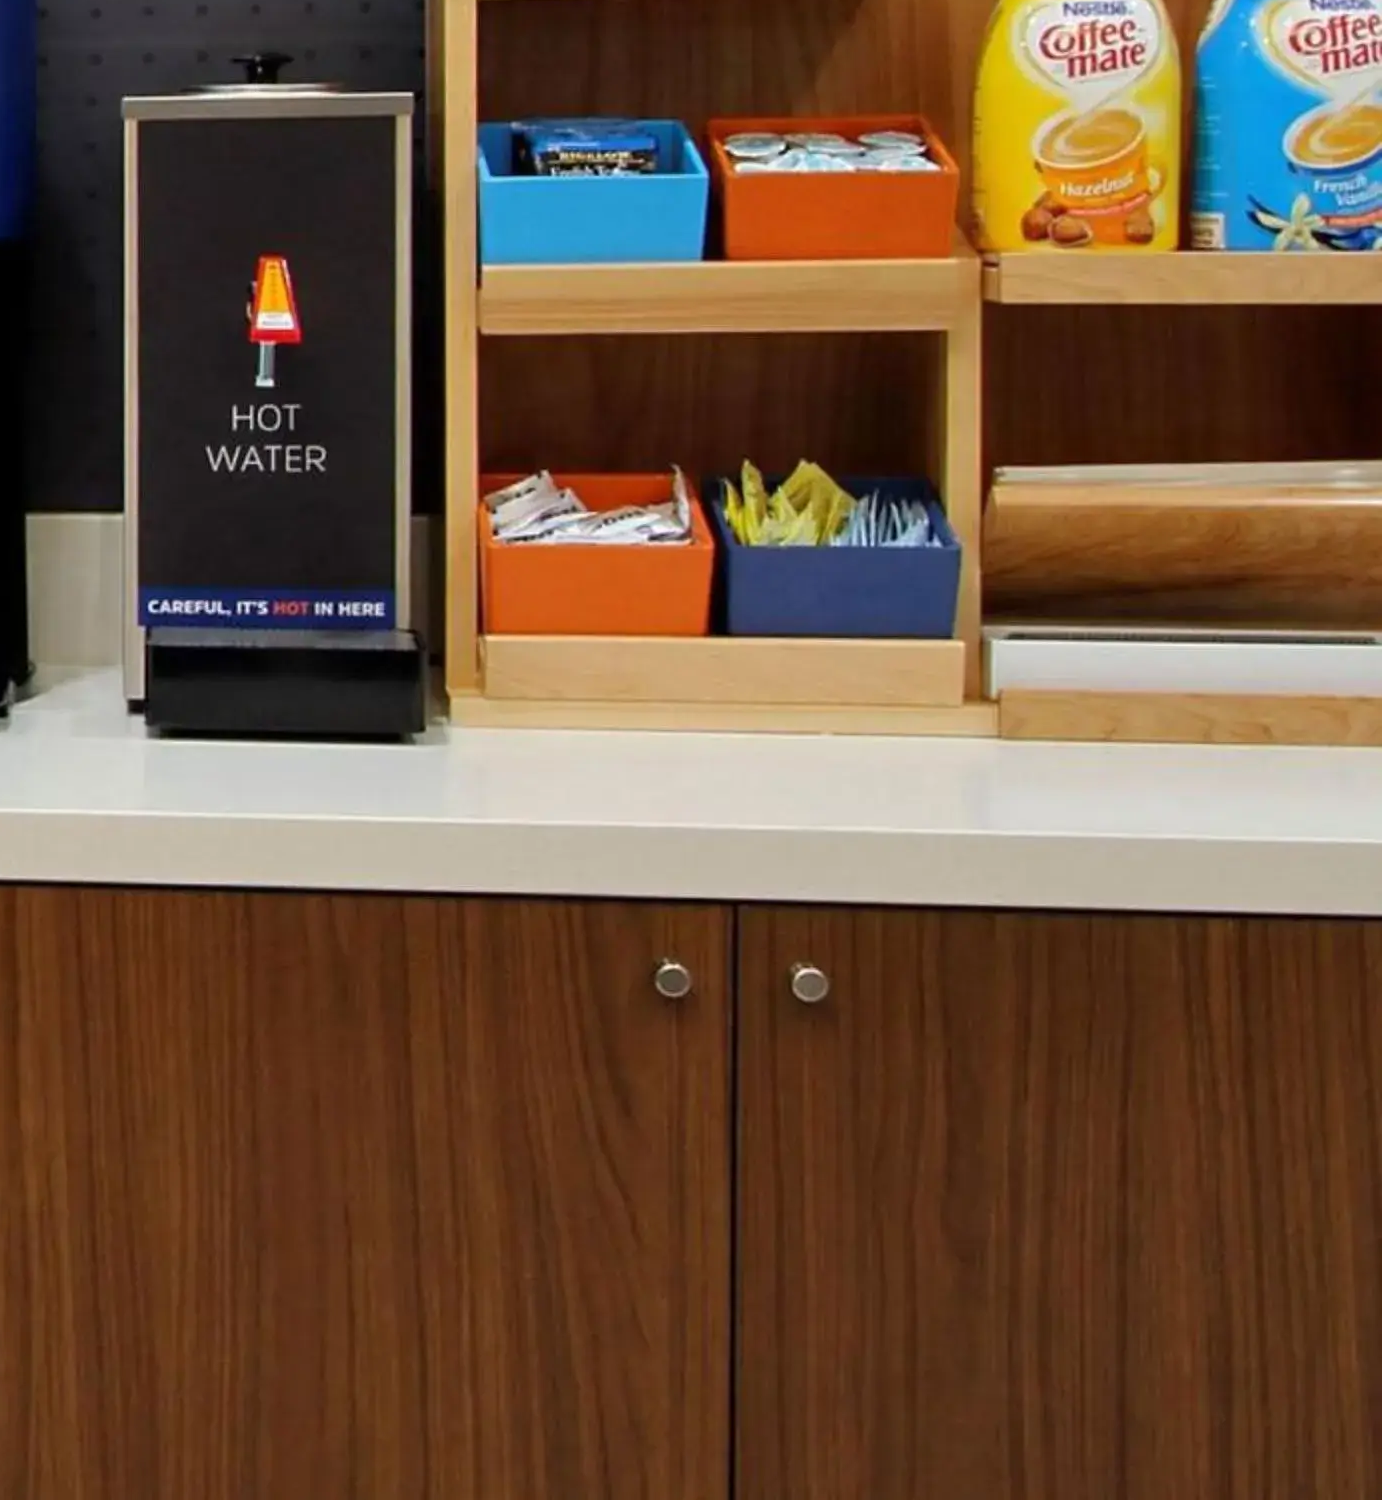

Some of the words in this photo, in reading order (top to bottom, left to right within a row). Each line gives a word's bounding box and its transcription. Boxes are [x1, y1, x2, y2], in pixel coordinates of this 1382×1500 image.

[1068, 43, 1146, 78] mate
[1322, 41, 1382, 73] mat
[231, 404, 302, 431] HOT
[205, 444, 327, 473] WATER
[147, 600, 232, 616] CAREFUL,
[236, 600, 268, 615] IT'S
[273, 601, 309, 615] HOT
[314, 602, 333, 616] IN
[338, 602, 385, 616] HERE
